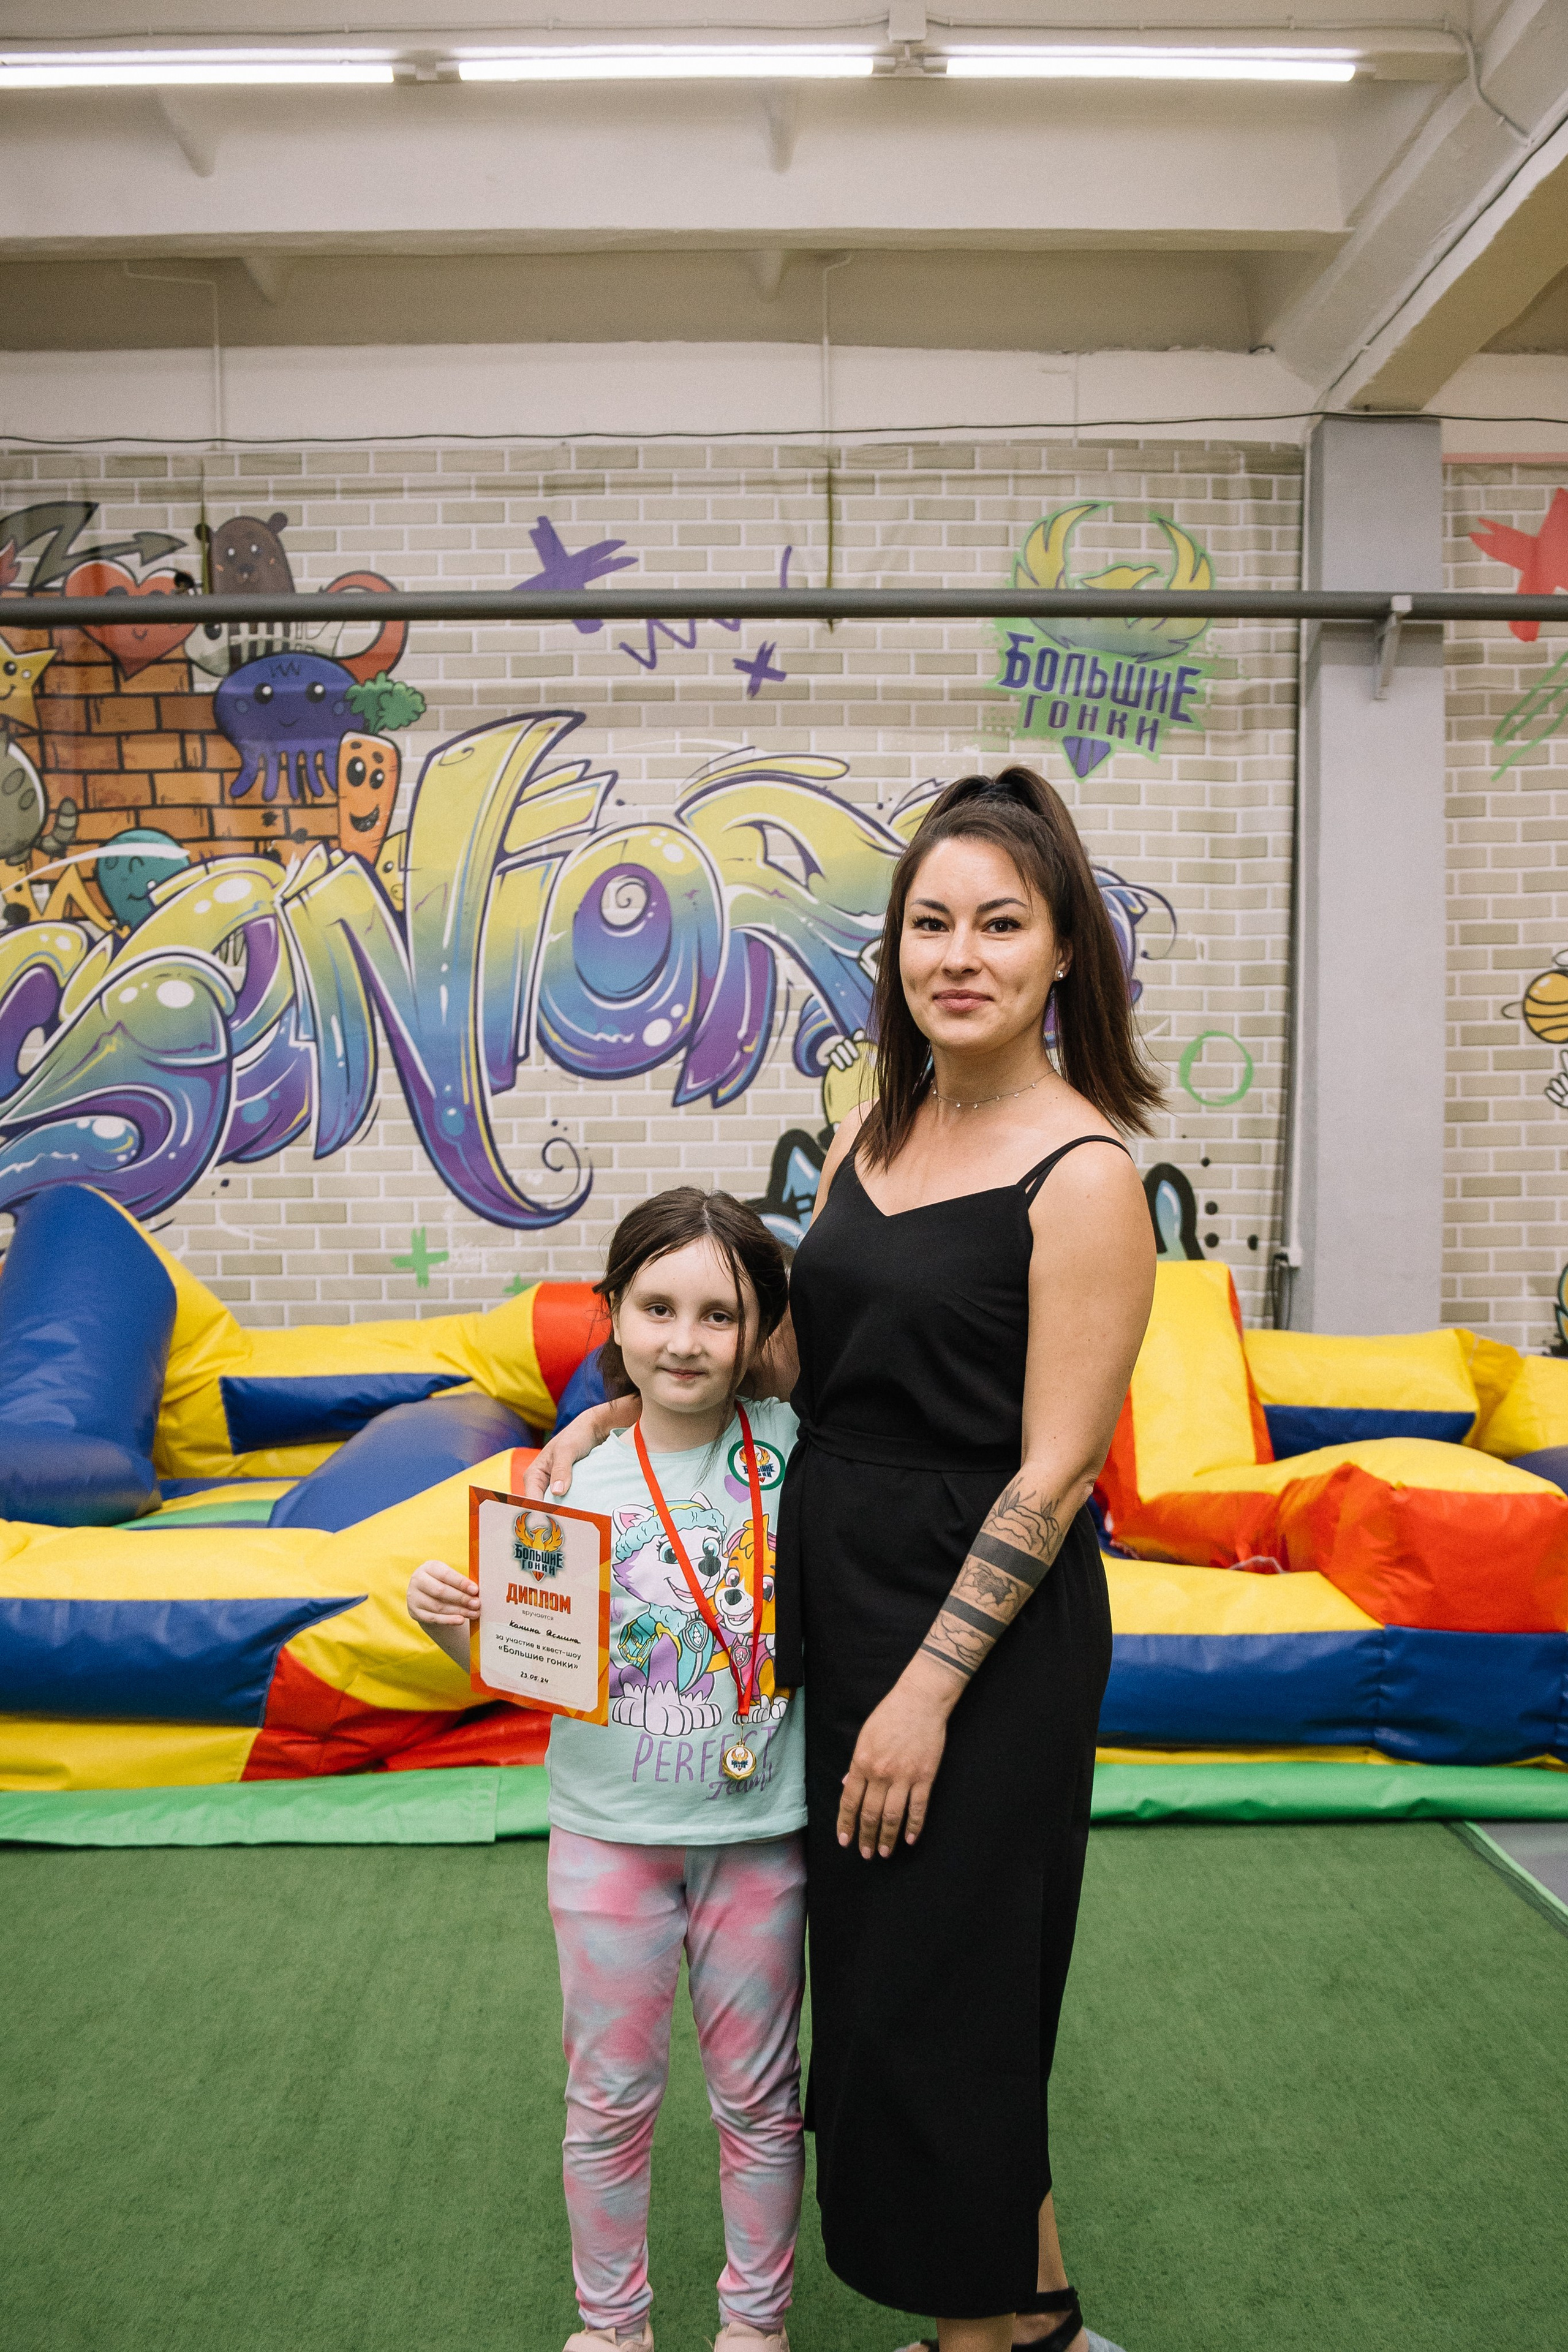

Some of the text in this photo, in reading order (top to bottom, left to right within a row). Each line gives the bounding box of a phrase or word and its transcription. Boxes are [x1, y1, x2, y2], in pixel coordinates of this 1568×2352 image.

[997, 630, 1203, 724] БОЛЬШИЕ
[1023, 694, 1161, 753] ГОНКИ
[514, 1543, 564, 1569] БОЛЬШИЕ
[522, 1559, 555, 1576] ГОНКИ
[506, 1582, 571, 1615] ДИПЛОМ
[522, 1610, 554, 1621] вручается
[498, 1645, 578, 1670] «Большие гонки»
[505, 1637, 535, 1648] участие
[542, 1645, 581, 1660] квест-шоу
